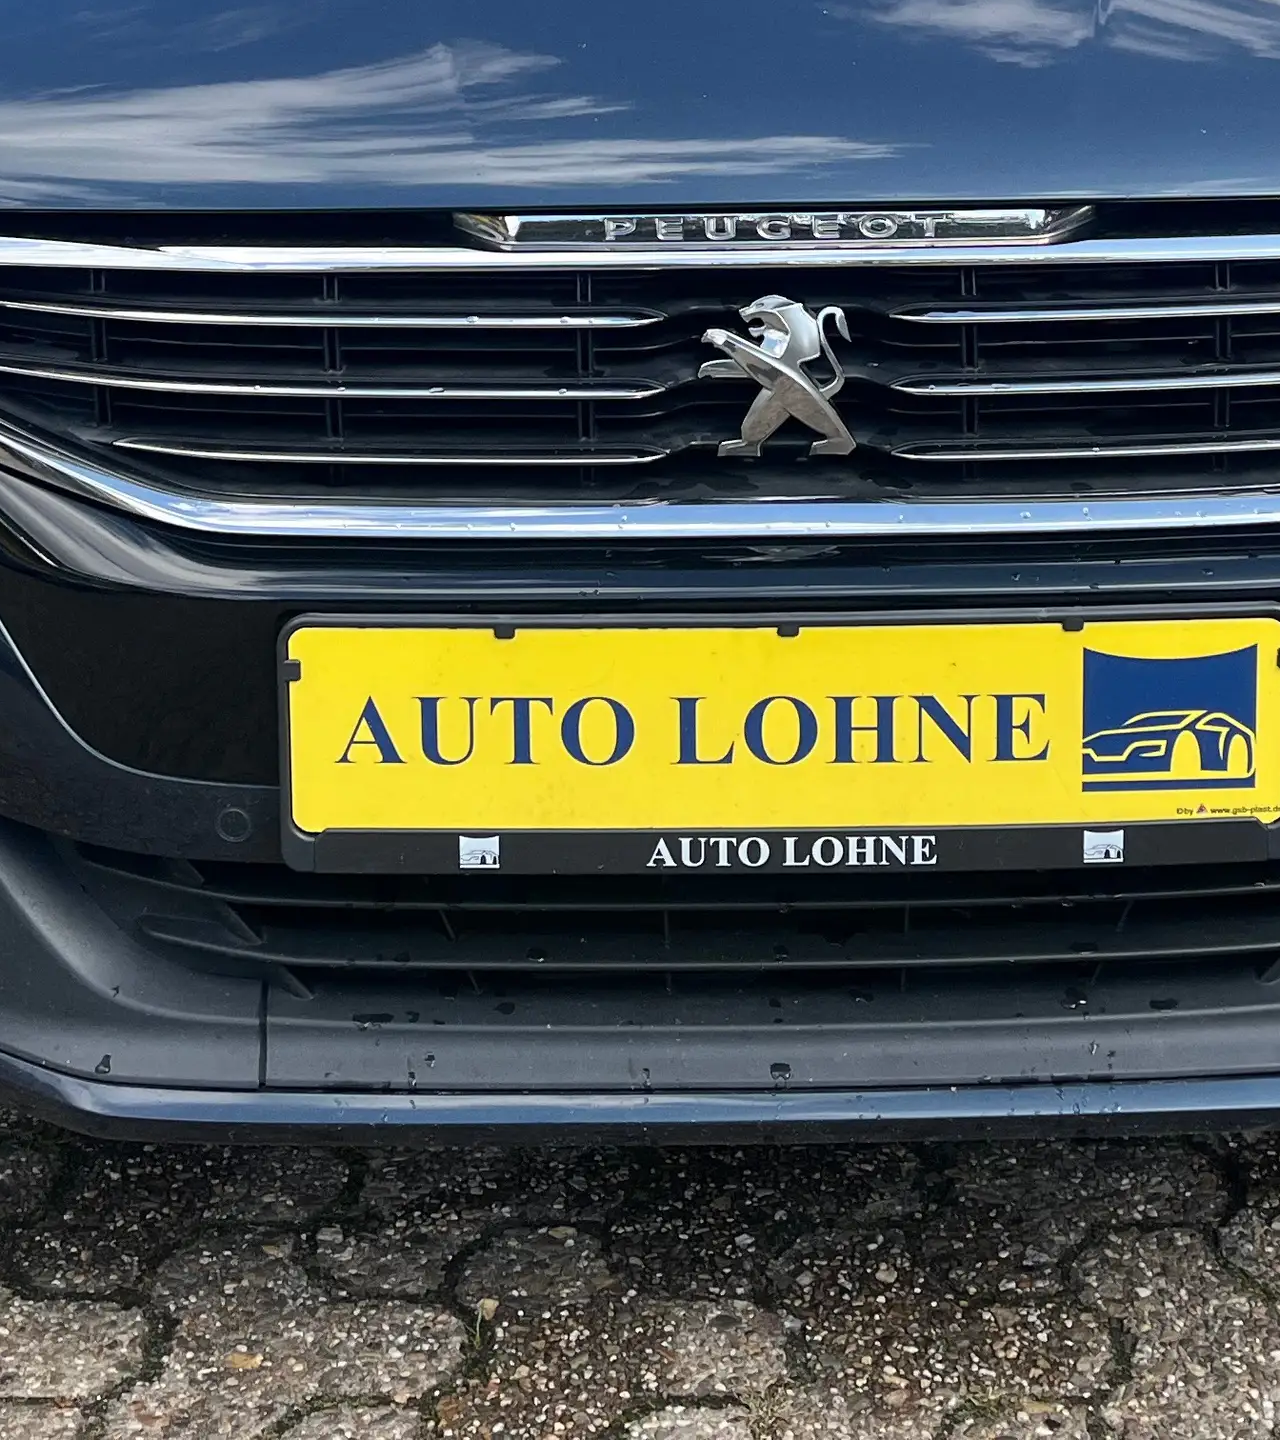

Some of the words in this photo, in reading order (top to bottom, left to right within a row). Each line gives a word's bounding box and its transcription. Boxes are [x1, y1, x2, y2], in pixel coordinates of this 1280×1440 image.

[604, 213, 947, 241] PEUGEOT
[334, 694, 636, 766] AUTO
[669, 692, 1050, 766] LOHNE
[646, 835, 773, 868] AUTO
[781, 833, 939, 867] LOHNE
